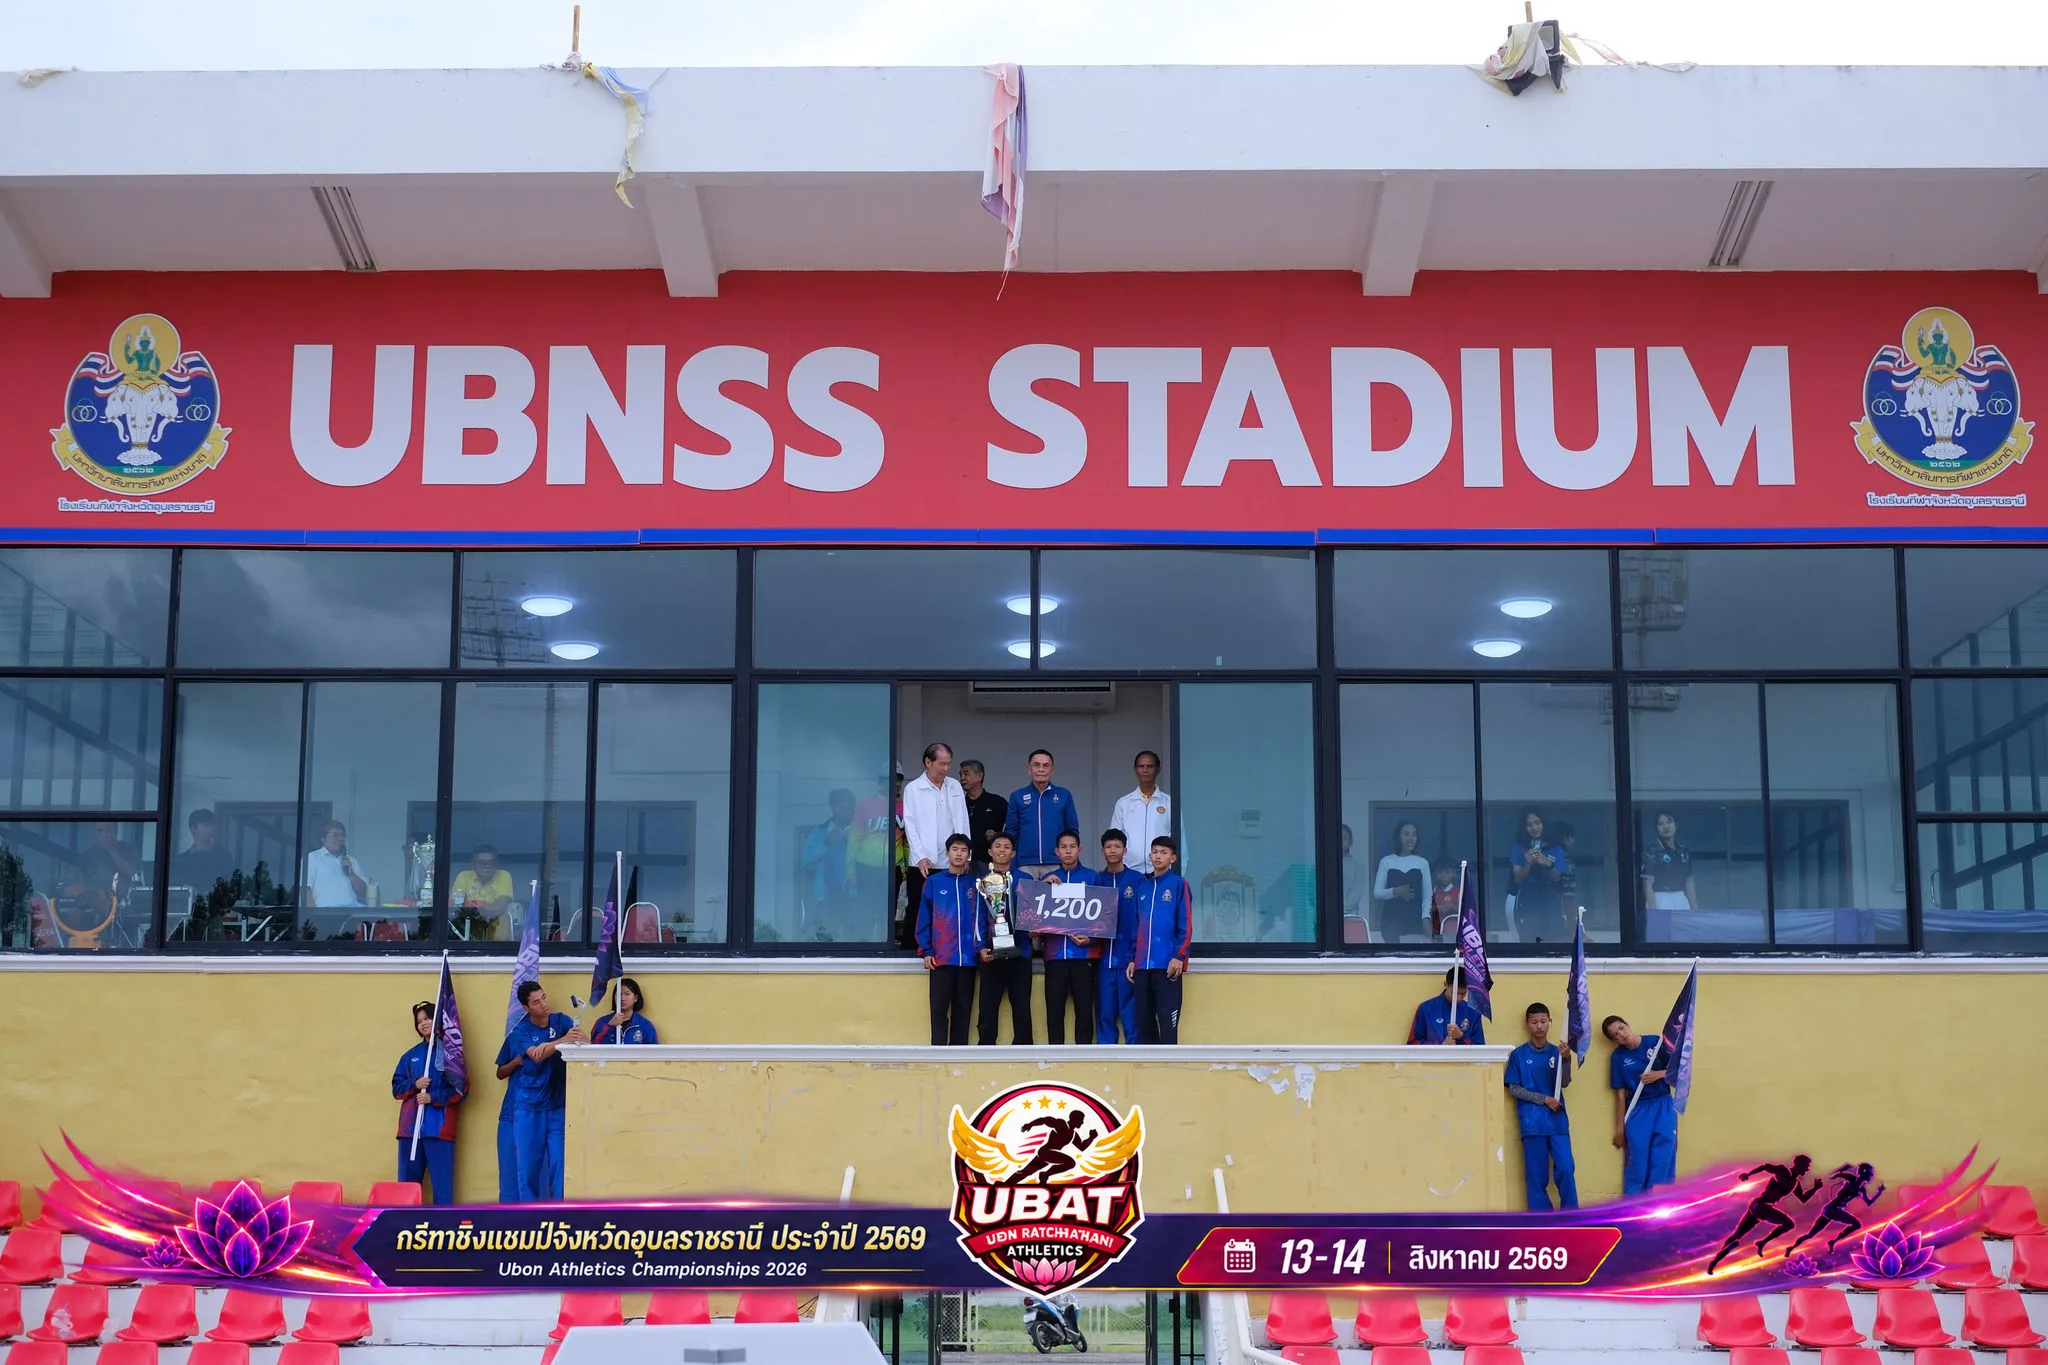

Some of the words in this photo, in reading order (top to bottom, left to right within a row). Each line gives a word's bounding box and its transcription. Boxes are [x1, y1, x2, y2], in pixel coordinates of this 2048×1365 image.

[290, 344, 885, 492] UBNSS
[987, 344, 1796, 490] STADIUM
[1035, 893, 1102, 920] 1,200
